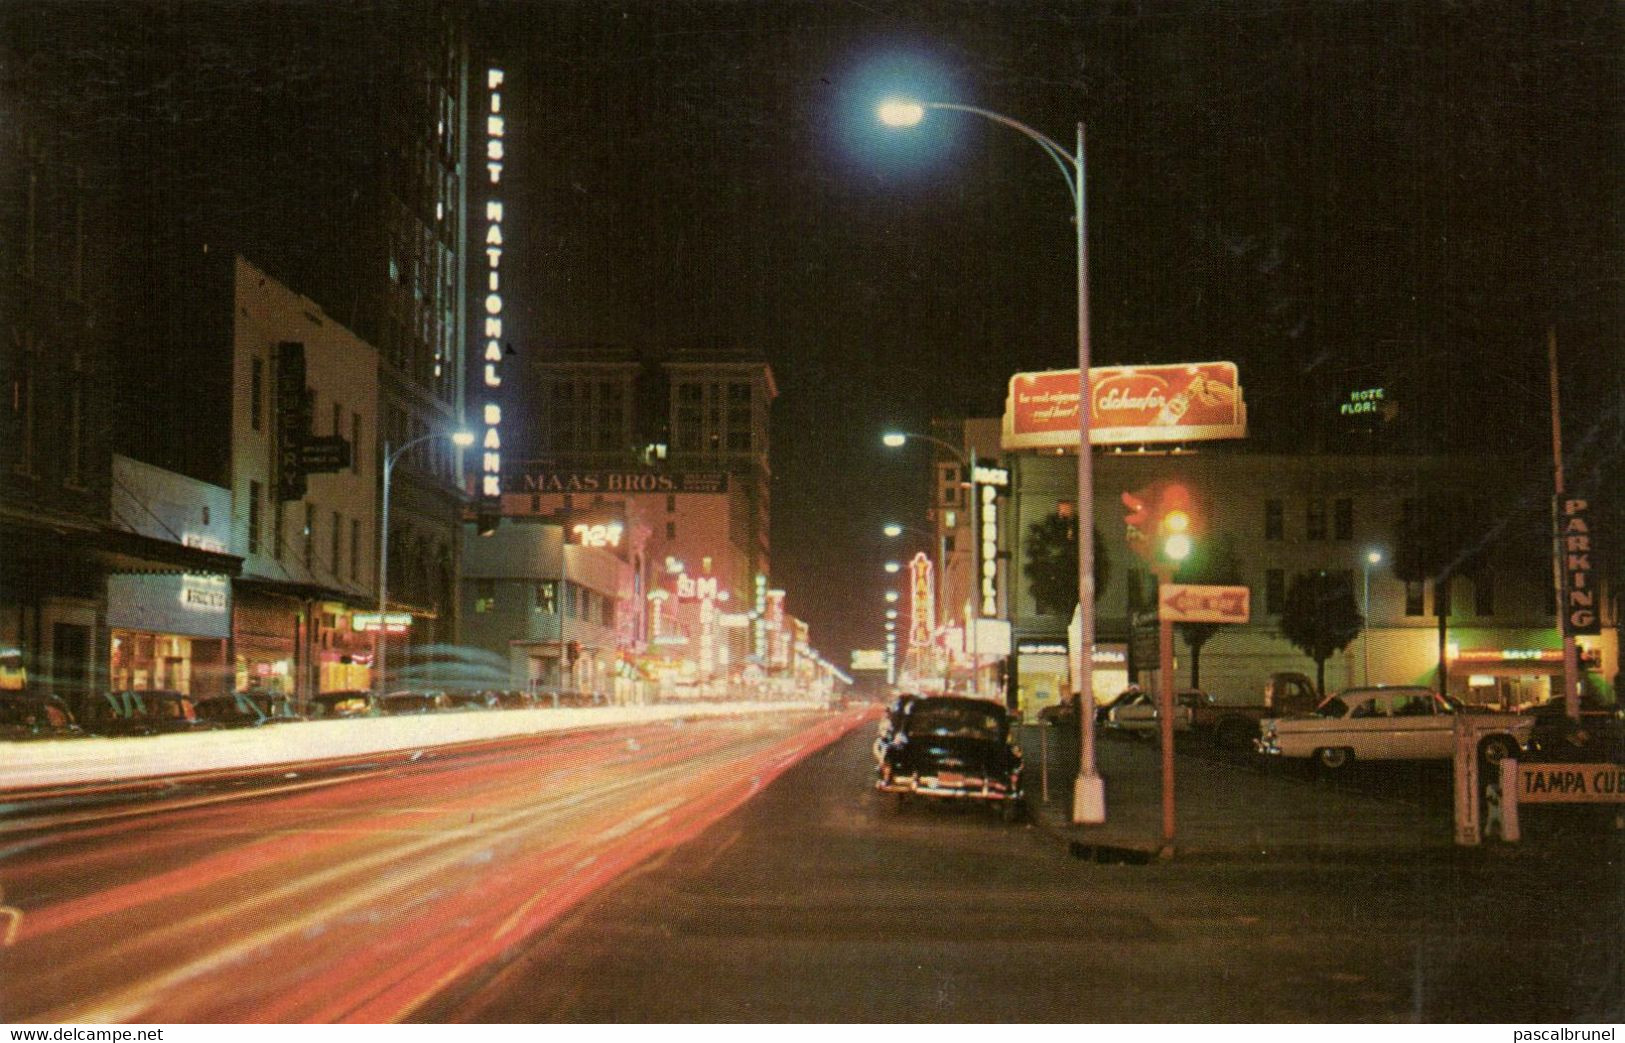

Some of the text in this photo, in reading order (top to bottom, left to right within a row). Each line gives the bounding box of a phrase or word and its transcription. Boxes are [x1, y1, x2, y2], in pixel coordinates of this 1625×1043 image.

[482, 69, 504, 497] FIRST NATIONAL BANK
[524, 474, 600, 491] MAAS
[607, 474, 679, 491] BROS.
[1564, 499, 1596, 627] PARKING
[1524, 771, 1586, 794] TAMPA
